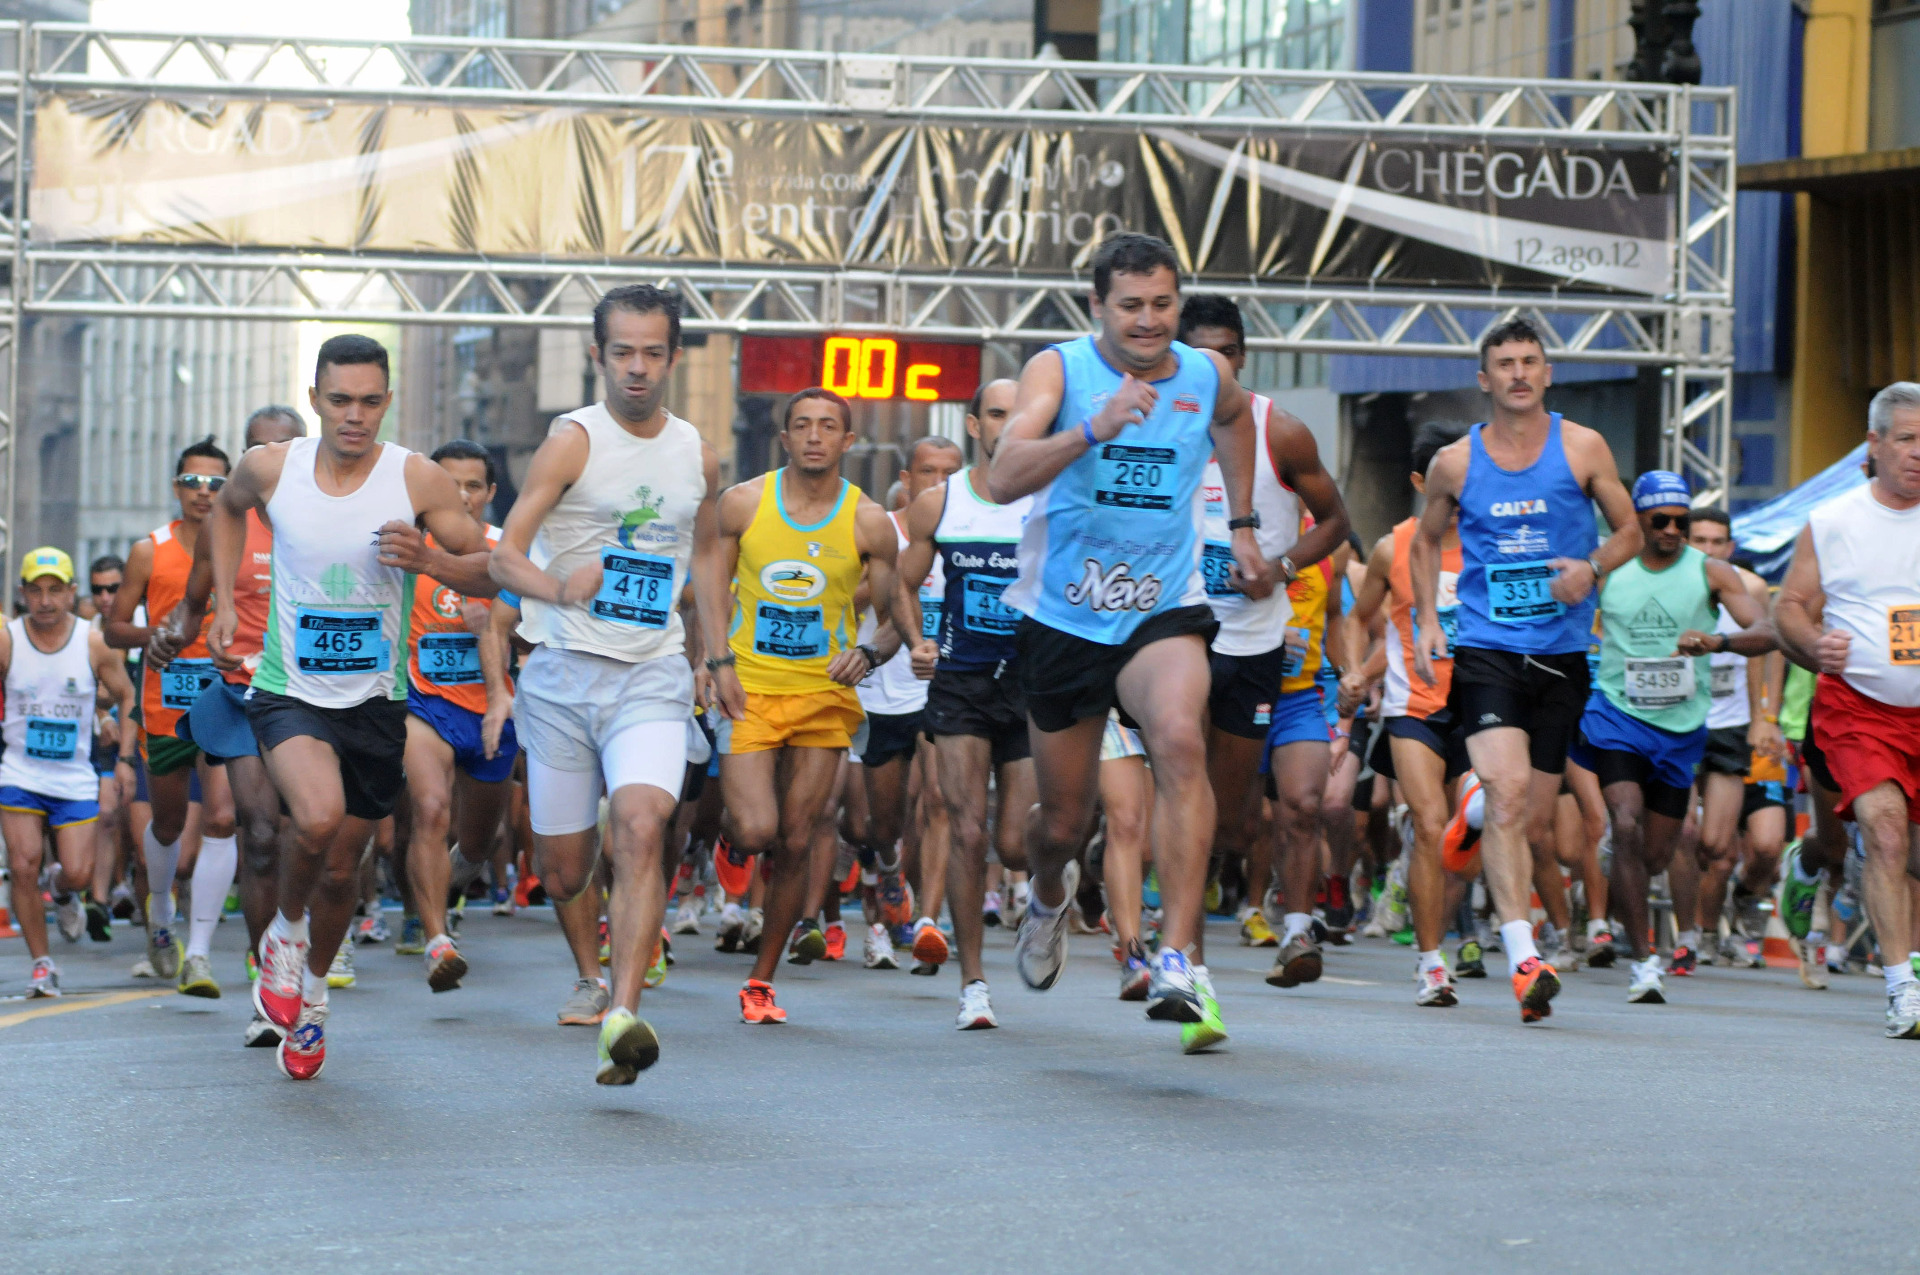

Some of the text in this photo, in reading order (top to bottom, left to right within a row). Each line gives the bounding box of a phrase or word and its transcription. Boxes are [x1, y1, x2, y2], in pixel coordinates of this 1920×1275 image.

[745, 173, 815, 191] orrida
[1374, 149, 1639, 201] CHEGADA
[1514, 237, 1640, 273] 12.ago.12
[1113, 462, 1162, 488] 260
[1490, 498, 1549, 517] CAIXA
[951, 550, 986, 568] Clube
[613, 574, 660, 602] 418
[1064, 557, 1163, 613] Neve
[1503, 580, 1542, 601] 331
[770, 620, 808, 640] 227
[1890, 623, 1920, 643] 21
[314, 631, 363, 653] 465
[433, 650, 468, 667] 387
[174, 675, 201, 692] 38
[1635, 671, 1680, 689] 5439
[38, 731, 67, 747] 119
